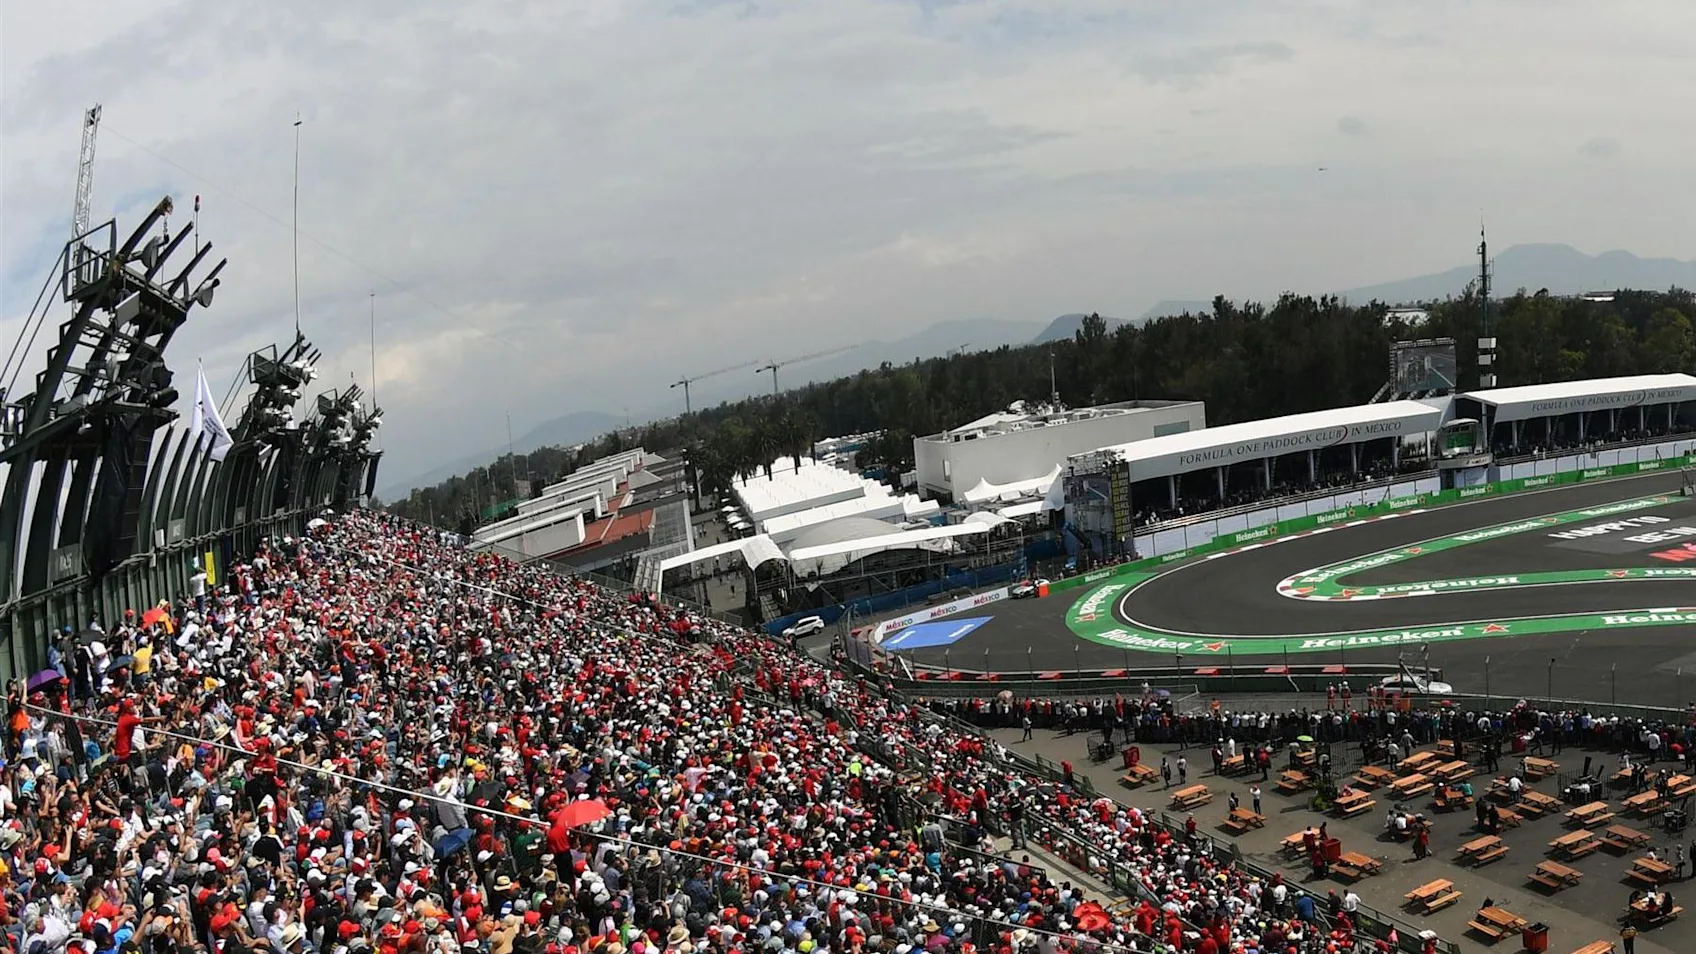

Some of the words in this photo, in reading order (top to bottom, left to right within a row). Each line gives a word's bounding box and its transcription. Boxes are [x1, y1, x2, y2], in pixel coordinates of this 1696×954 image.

[1180, 449, 1233, 465] FORMULA
[1236, 442, 1261, 455] ONE
[1263, 434, 1312, 450] PADDOCK
[1315, 428, 1345, 442] CLUB
[1350, 427, 1363, 437] IN
[1460, 485, 1486, 497] Heineken
[1389, 498, 1419, 509] Heineken
[1317, 511, 1348, 524] Heineken
[1236, 528, 1268, 542] Heineken
[1623, 531, 1681, 544] BE
[1162, 551, 1187, 562] Heineken
[1097, 629, 1193, 650] Heineken
[1299, 626, 1465, 649] Heineken
